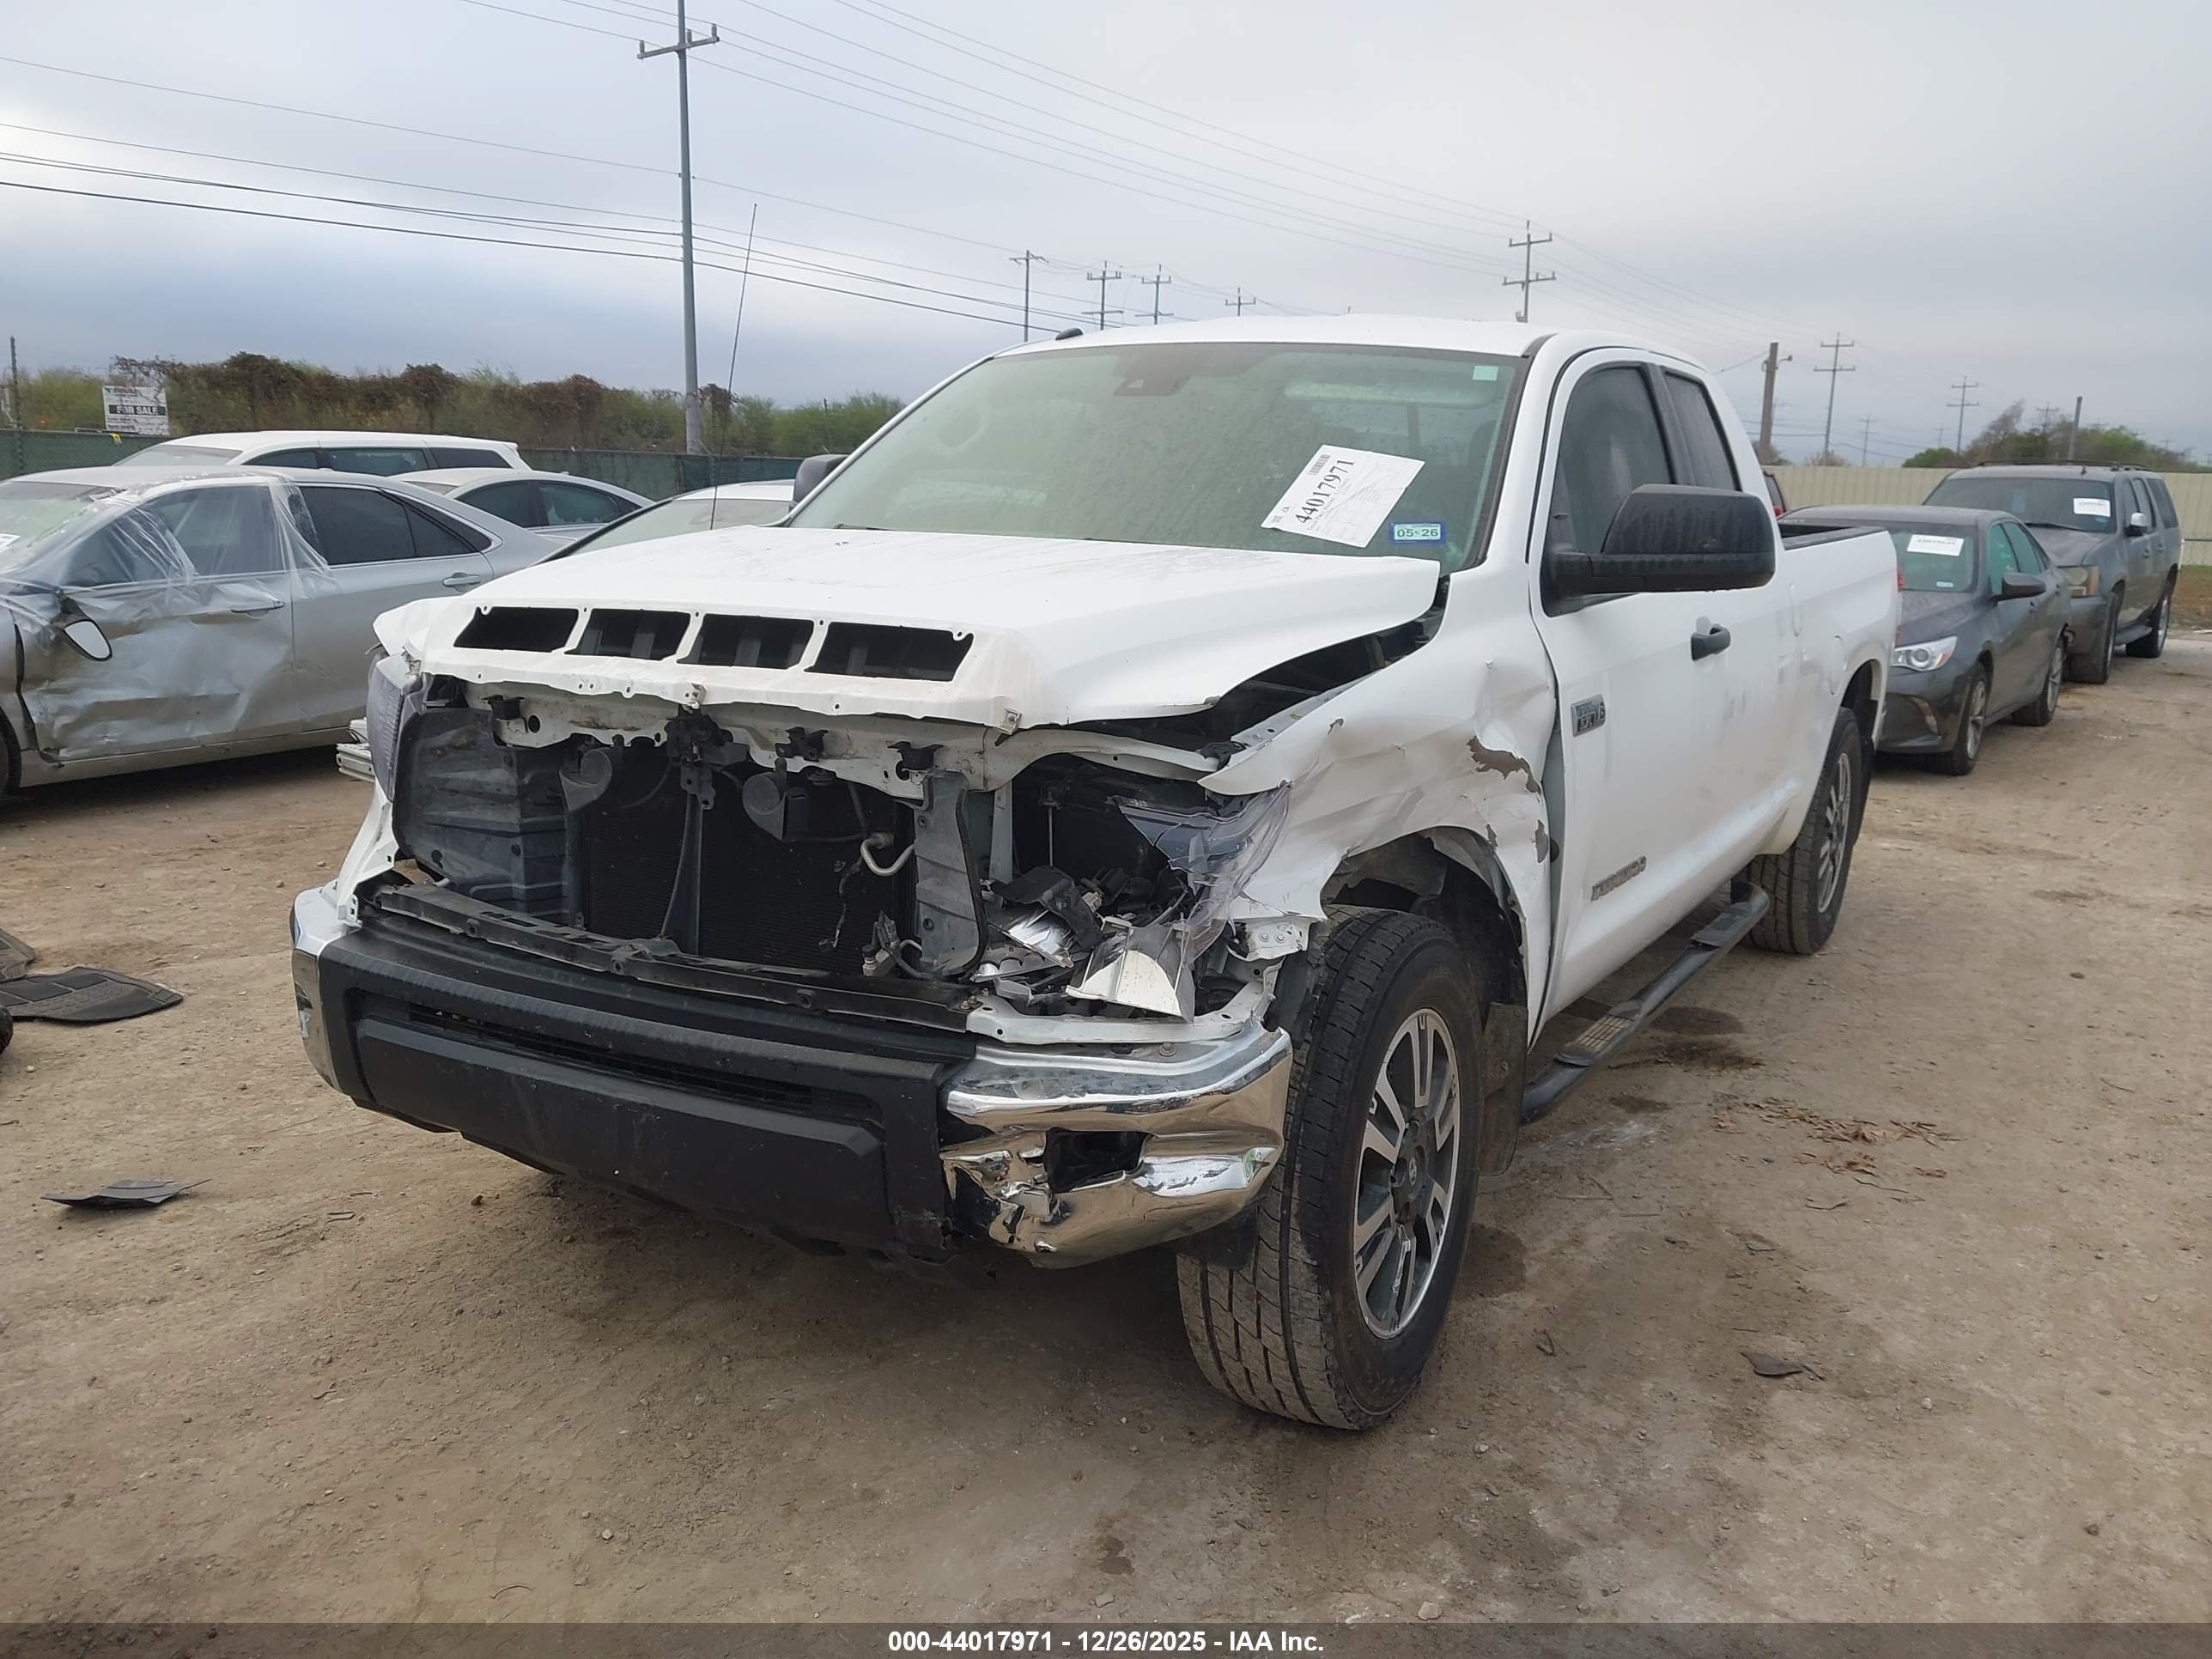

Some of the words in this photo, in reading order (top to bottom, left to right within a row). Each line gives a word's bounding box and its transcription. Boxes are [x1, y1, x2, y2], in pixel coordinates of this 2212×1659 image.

[137, 406, 158, 415] SALE
[1295, 460, 1355, 524] 44017971
[1397, 529, 1413, 538] 05
